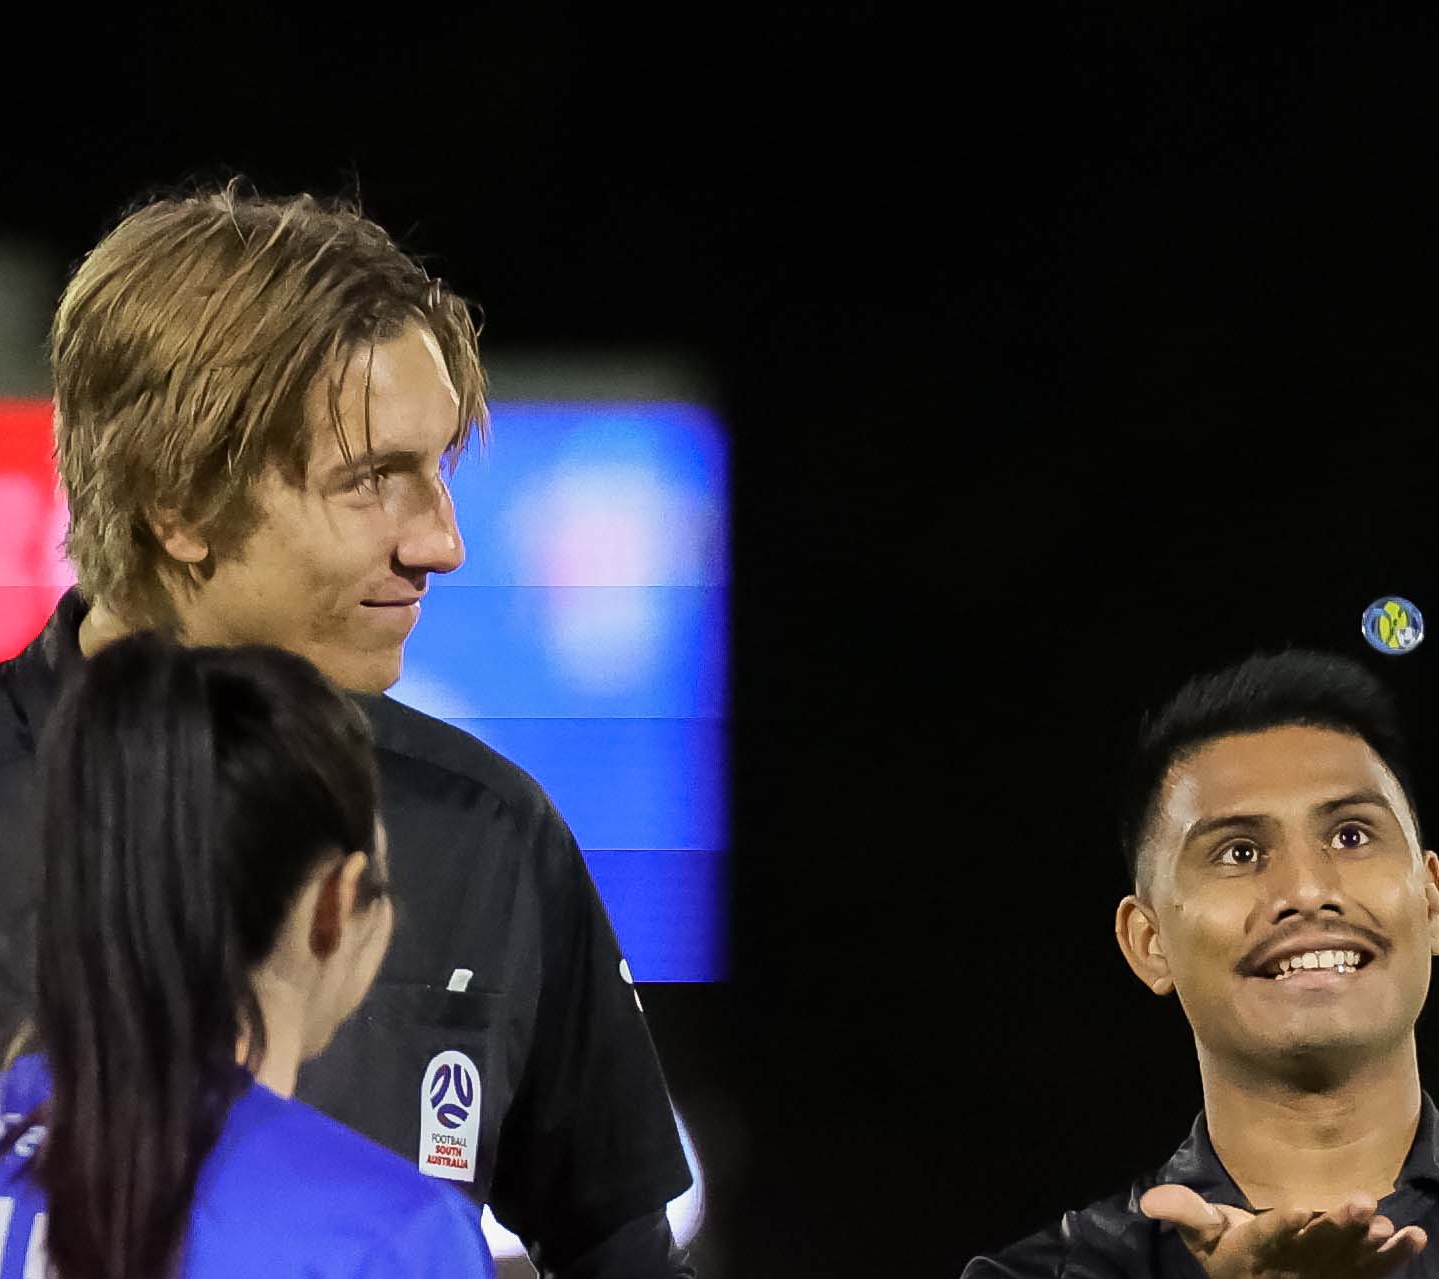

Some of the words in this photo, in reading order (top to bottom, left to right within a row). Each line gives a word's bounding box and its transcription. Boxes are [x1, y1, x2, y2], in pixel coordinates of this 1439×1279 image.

[431, 1132, 468, 1148] FOOTBALL
[435, 1144, 463, 1157] SOUTH
[426, 1154, 468, 1169] AUSTRALIA
